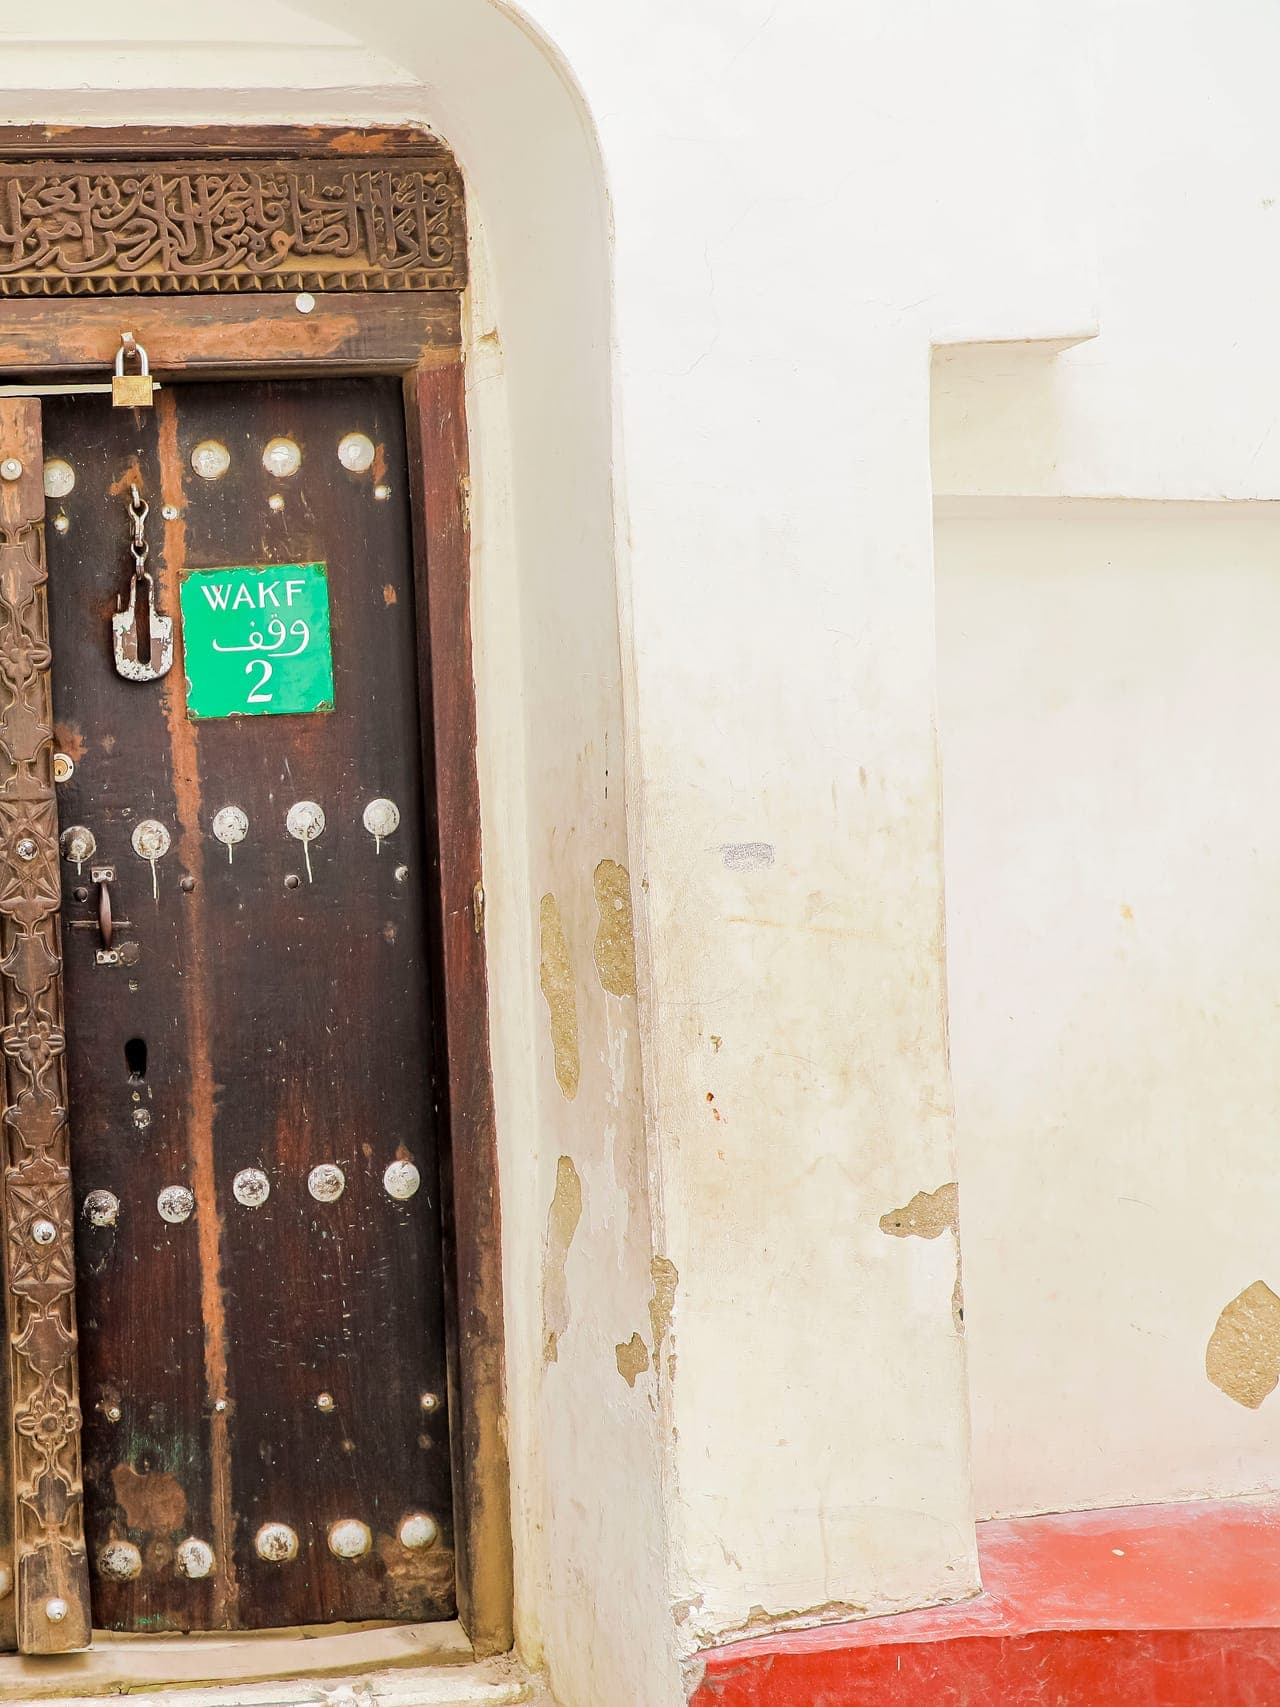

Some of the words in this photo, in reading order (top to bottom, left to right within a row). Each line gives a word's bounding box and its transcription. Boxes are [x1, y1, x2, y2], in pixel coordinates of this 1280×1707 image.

[200, 579, 306, 612] WAKF
[212, 613, 310, 657] وقف
[245, 659, 273, 703] 2
